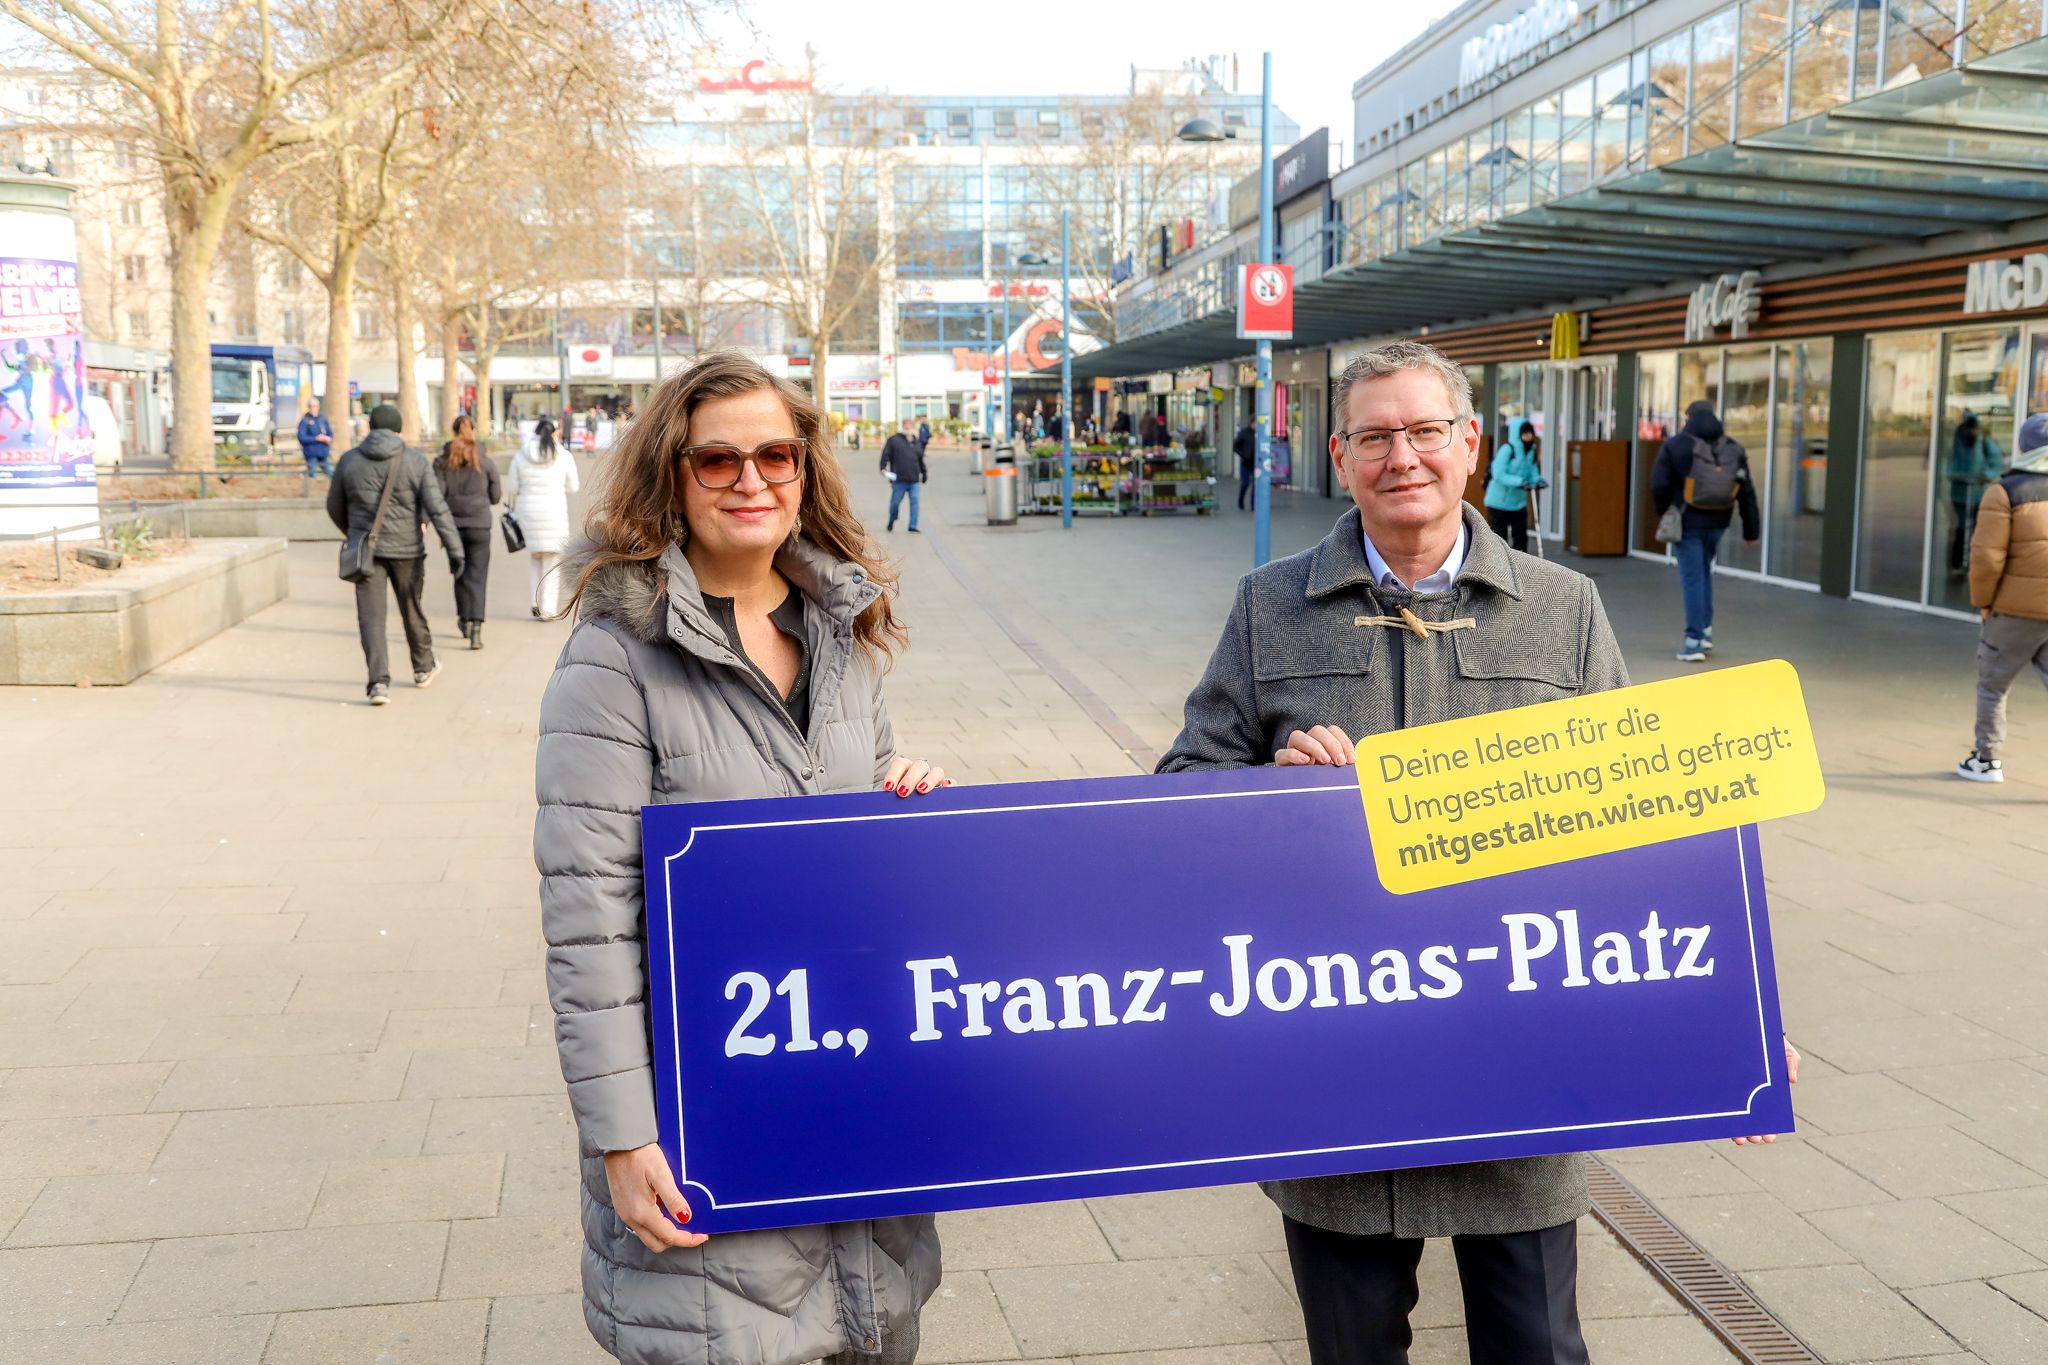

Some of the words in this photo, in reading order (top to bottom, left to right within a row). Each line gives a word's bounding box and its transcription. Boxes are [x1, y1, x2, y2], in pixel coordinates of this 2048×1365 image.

[1963, 253, 2048, 314] McD
[1380, 748, 1469, 783] Deine
[1475, 732, 1560, 765] Ideen
[1565, 717, 1608, 747] für
[1616, 707, 1661, 737] die
[1387, 766, 1603, 824] Umgestaltung
[1609, 744, 1670, 782] sind
[1677, 726, 1792, 776] gefragt:
[1398, 773, 1760, 867] mitgestalten.wien.gv.at
[724, 968, 869, 1058] 21.,
[905, 908, 1715, 1042] Franz-Jonas-Platz
